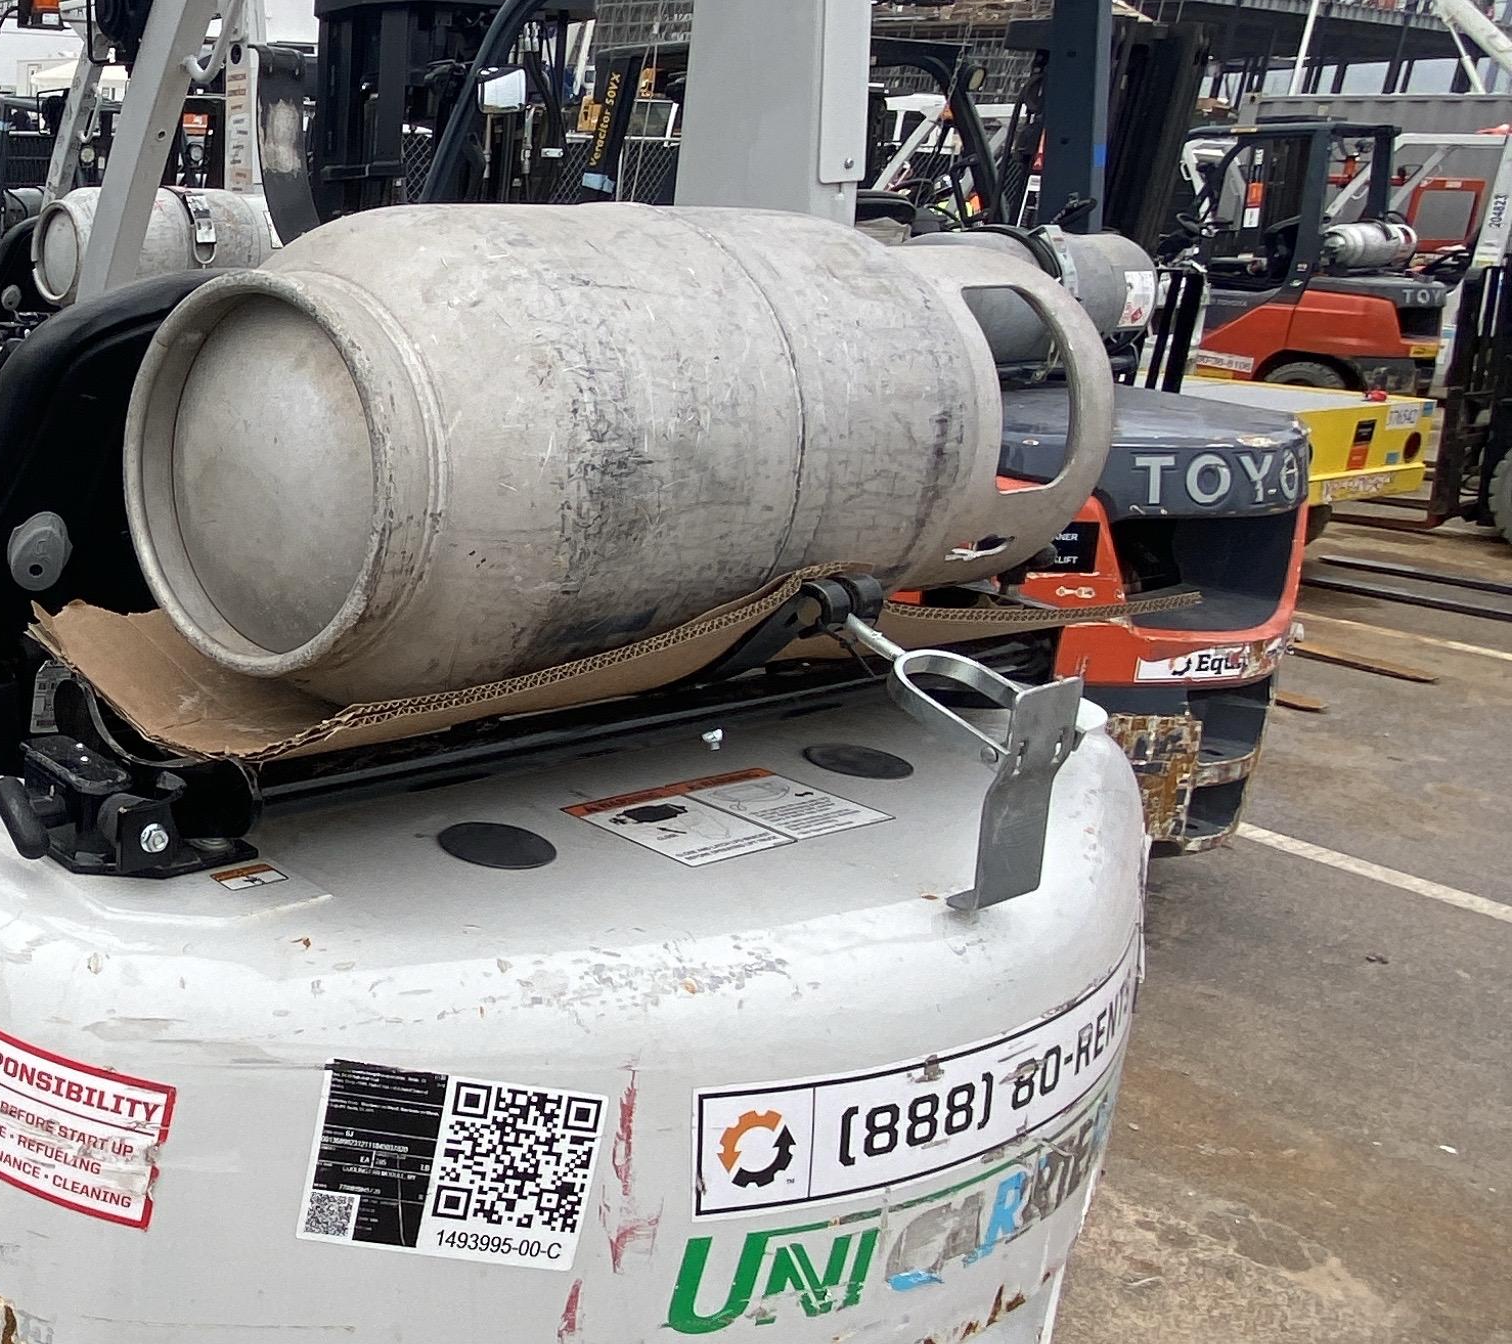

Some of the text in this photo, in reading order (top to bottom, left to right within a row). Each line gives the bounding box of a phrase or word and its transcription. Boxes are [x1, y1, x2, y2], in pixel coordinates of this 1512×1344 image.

[0, 1101, 56, 1134] BEFORE
[58, 1125, 109, 1150] START
[111, 1140, 134, 1158] UP
[838, 1071, 994, 1166] (888)
[17, 1134, 103, 1175] REFUELING
[52, 1174, 133, 1209] CLEANING
[436, 1229, 562, 1260] 1493995-00-C
